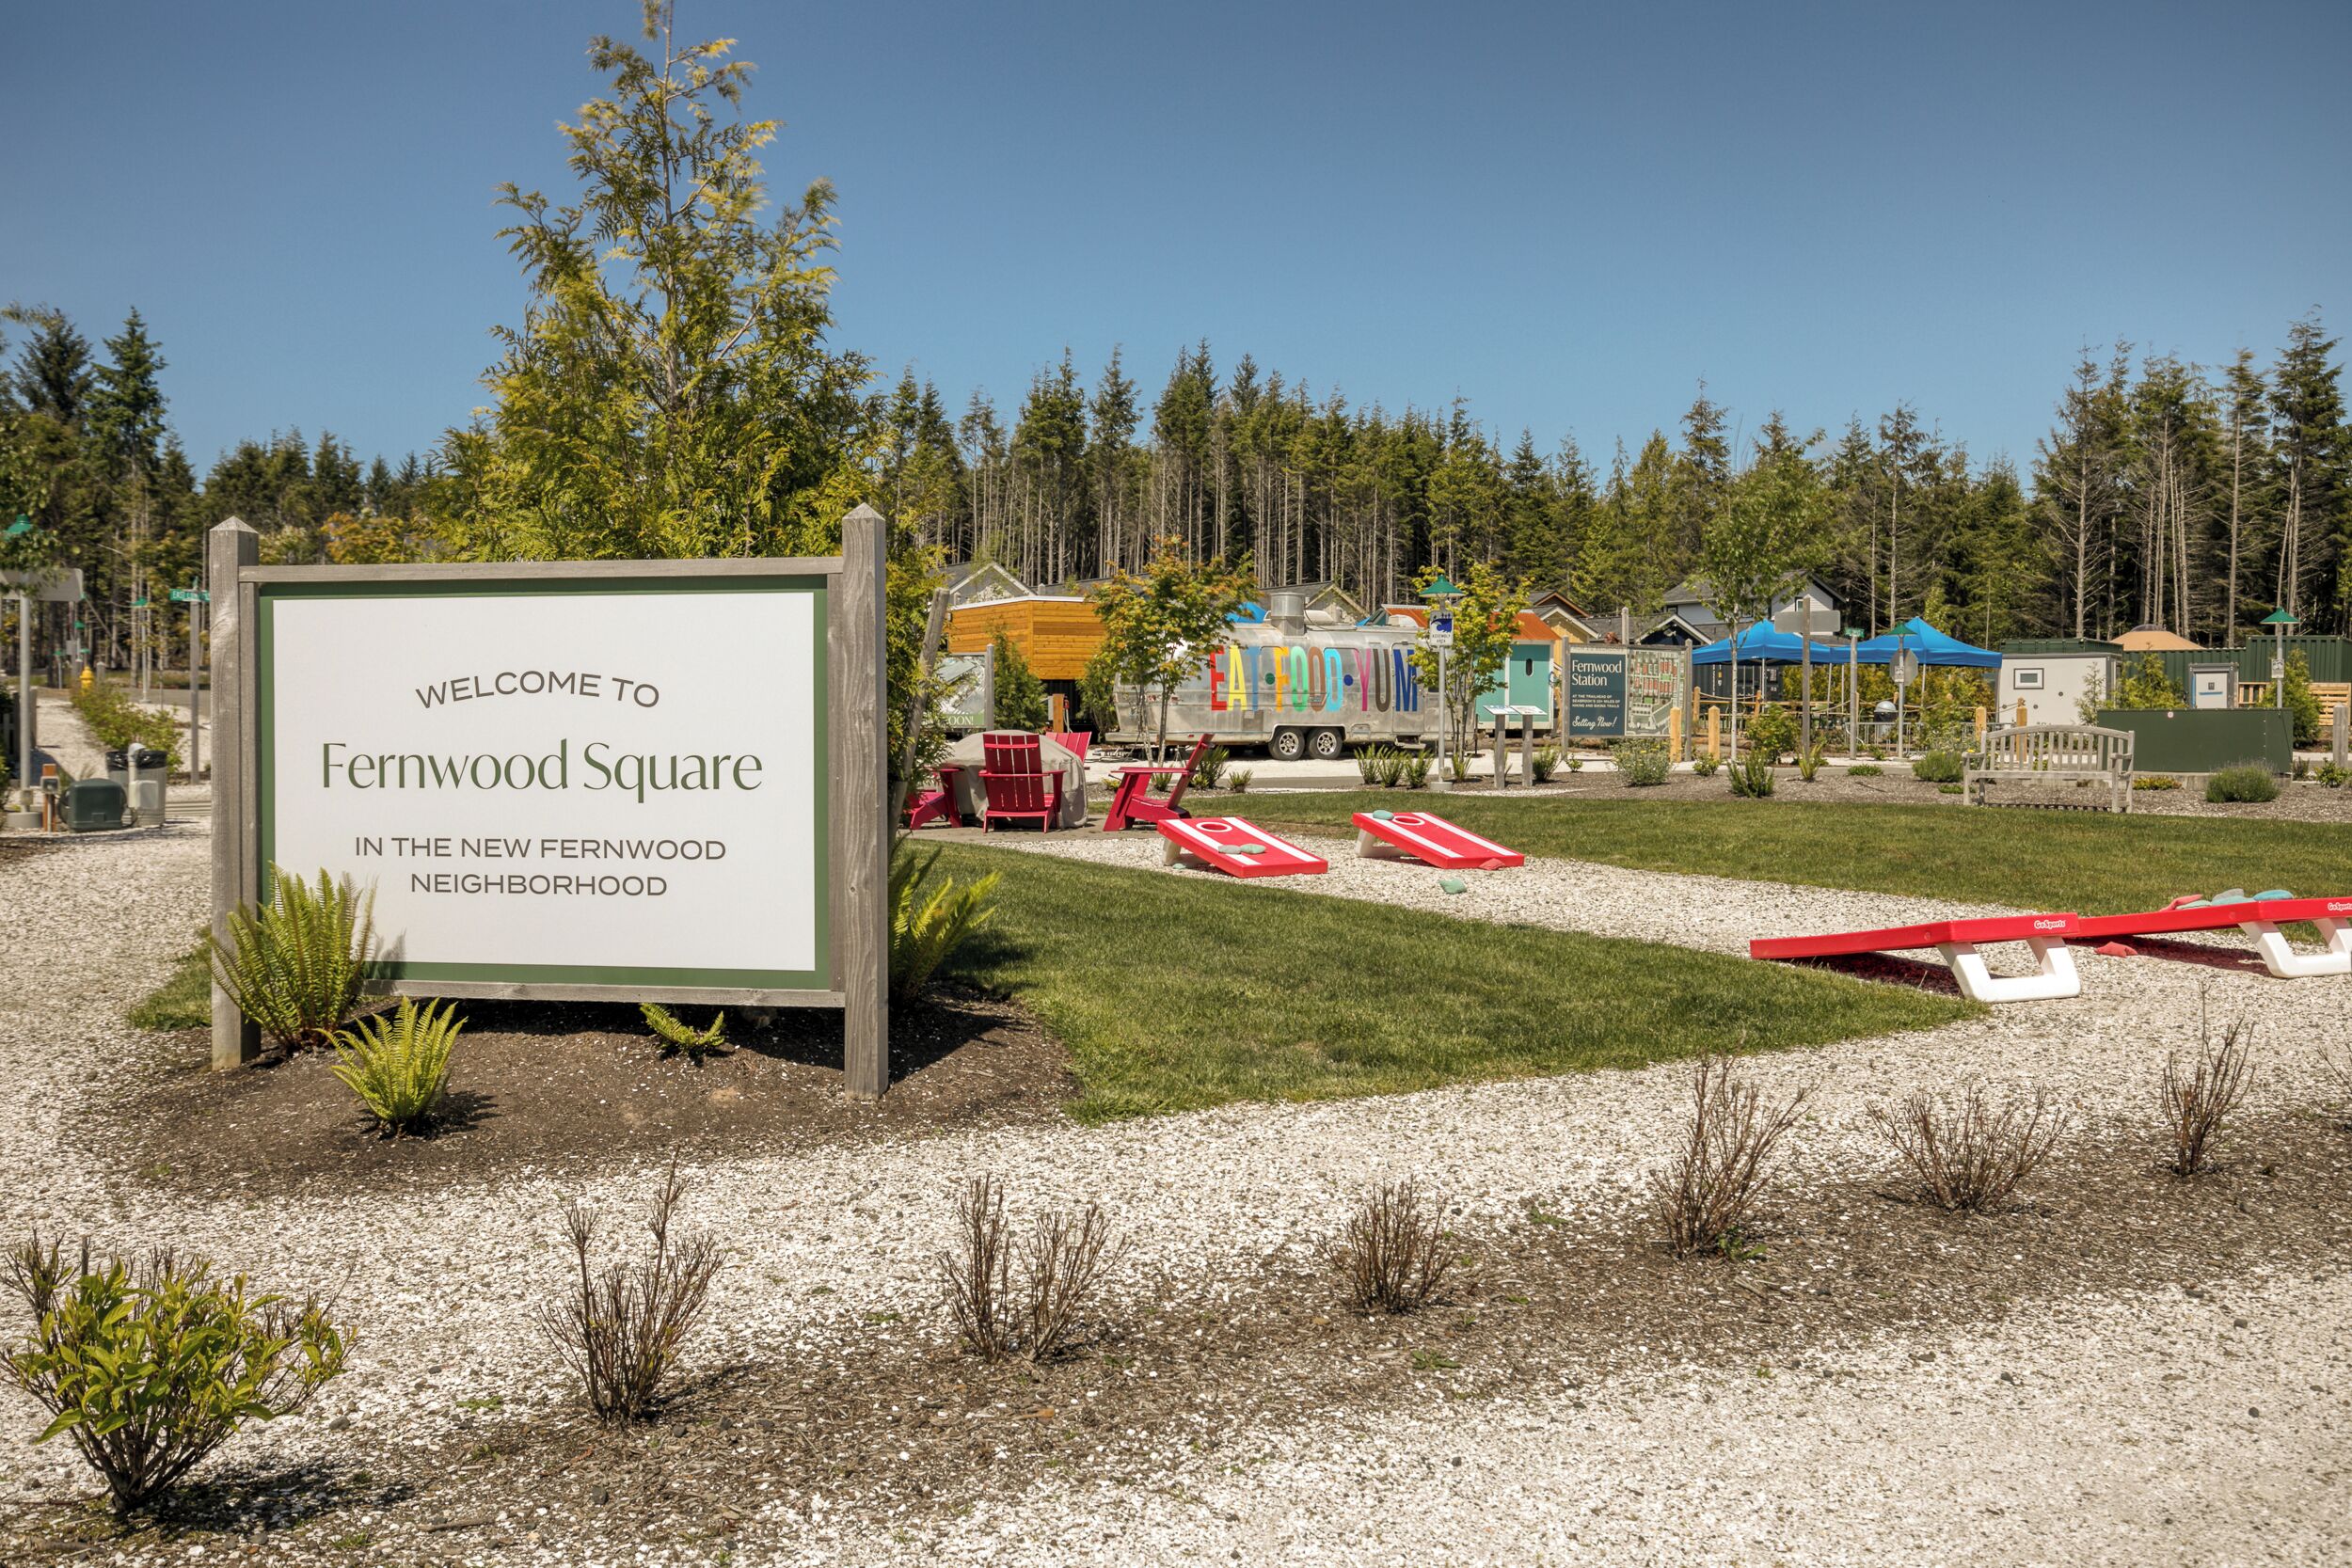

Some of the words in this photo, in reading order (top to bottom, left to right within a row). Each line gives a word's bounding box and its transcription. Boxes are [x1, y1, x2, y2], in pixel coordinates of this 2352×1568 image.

[1572, 659, 1622, 673] Fernwood
[1209, 644, 1259, 711] EAT
[1273, 645, 1343, 712] FOOD
[1353, 648, 1418, 712] YUM
[1571, 673, 1608, 686] Station
[415, 671, 602, 709] WELCOME
[612, 676, 660, 708] TO
[948, 715, 974, 726] OON!
[1572, 715, 1596, 731] Selling
[1597, 715, 1617, 728] Now!
[323, 737, 568, 790] Fernwood
[583, 742, 763, 804] Square
[356, 836, 383, 857] IN
[390, 837, 453, 857] THE
[461, 837, 532, 858] NEW
[540, 838, 726, 861] FERNWOOD
[411, 873, 668, 896] NEIGHBORHOOD
[2034, 920, 2066, 929] GoSports
